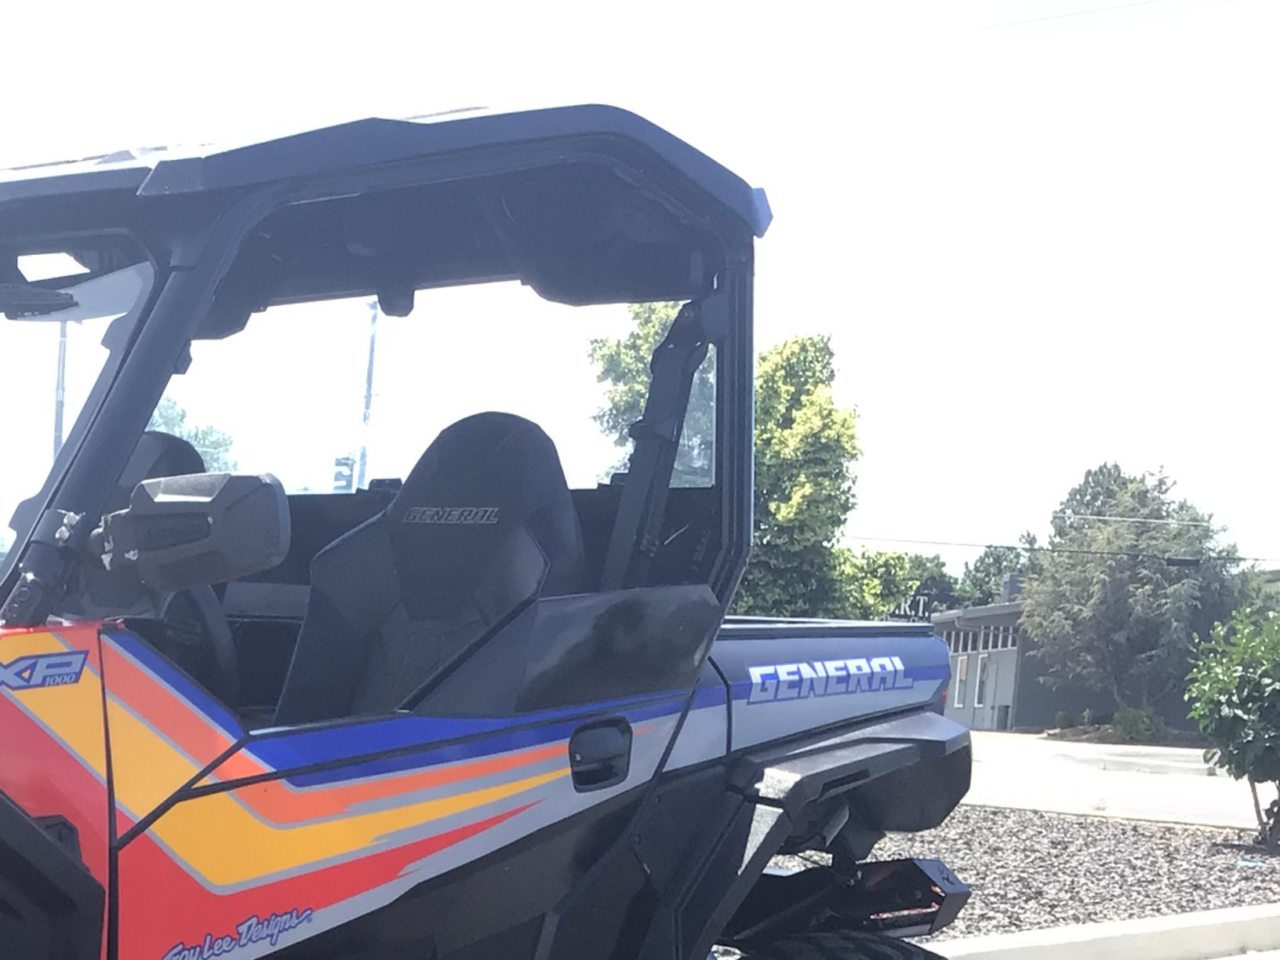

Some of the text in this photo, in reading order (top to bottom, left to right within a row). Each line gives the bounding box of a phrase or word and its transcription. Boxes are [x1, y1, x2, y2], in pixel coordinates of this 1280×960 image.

[402, 506, 499, 524] GENERAL
[45, 673, 76, 687] 1000
[747, 655, 914, 705] GENERAL
[200, 933, 238, 960] Lee
[236, 908, 313, 946] Designs
